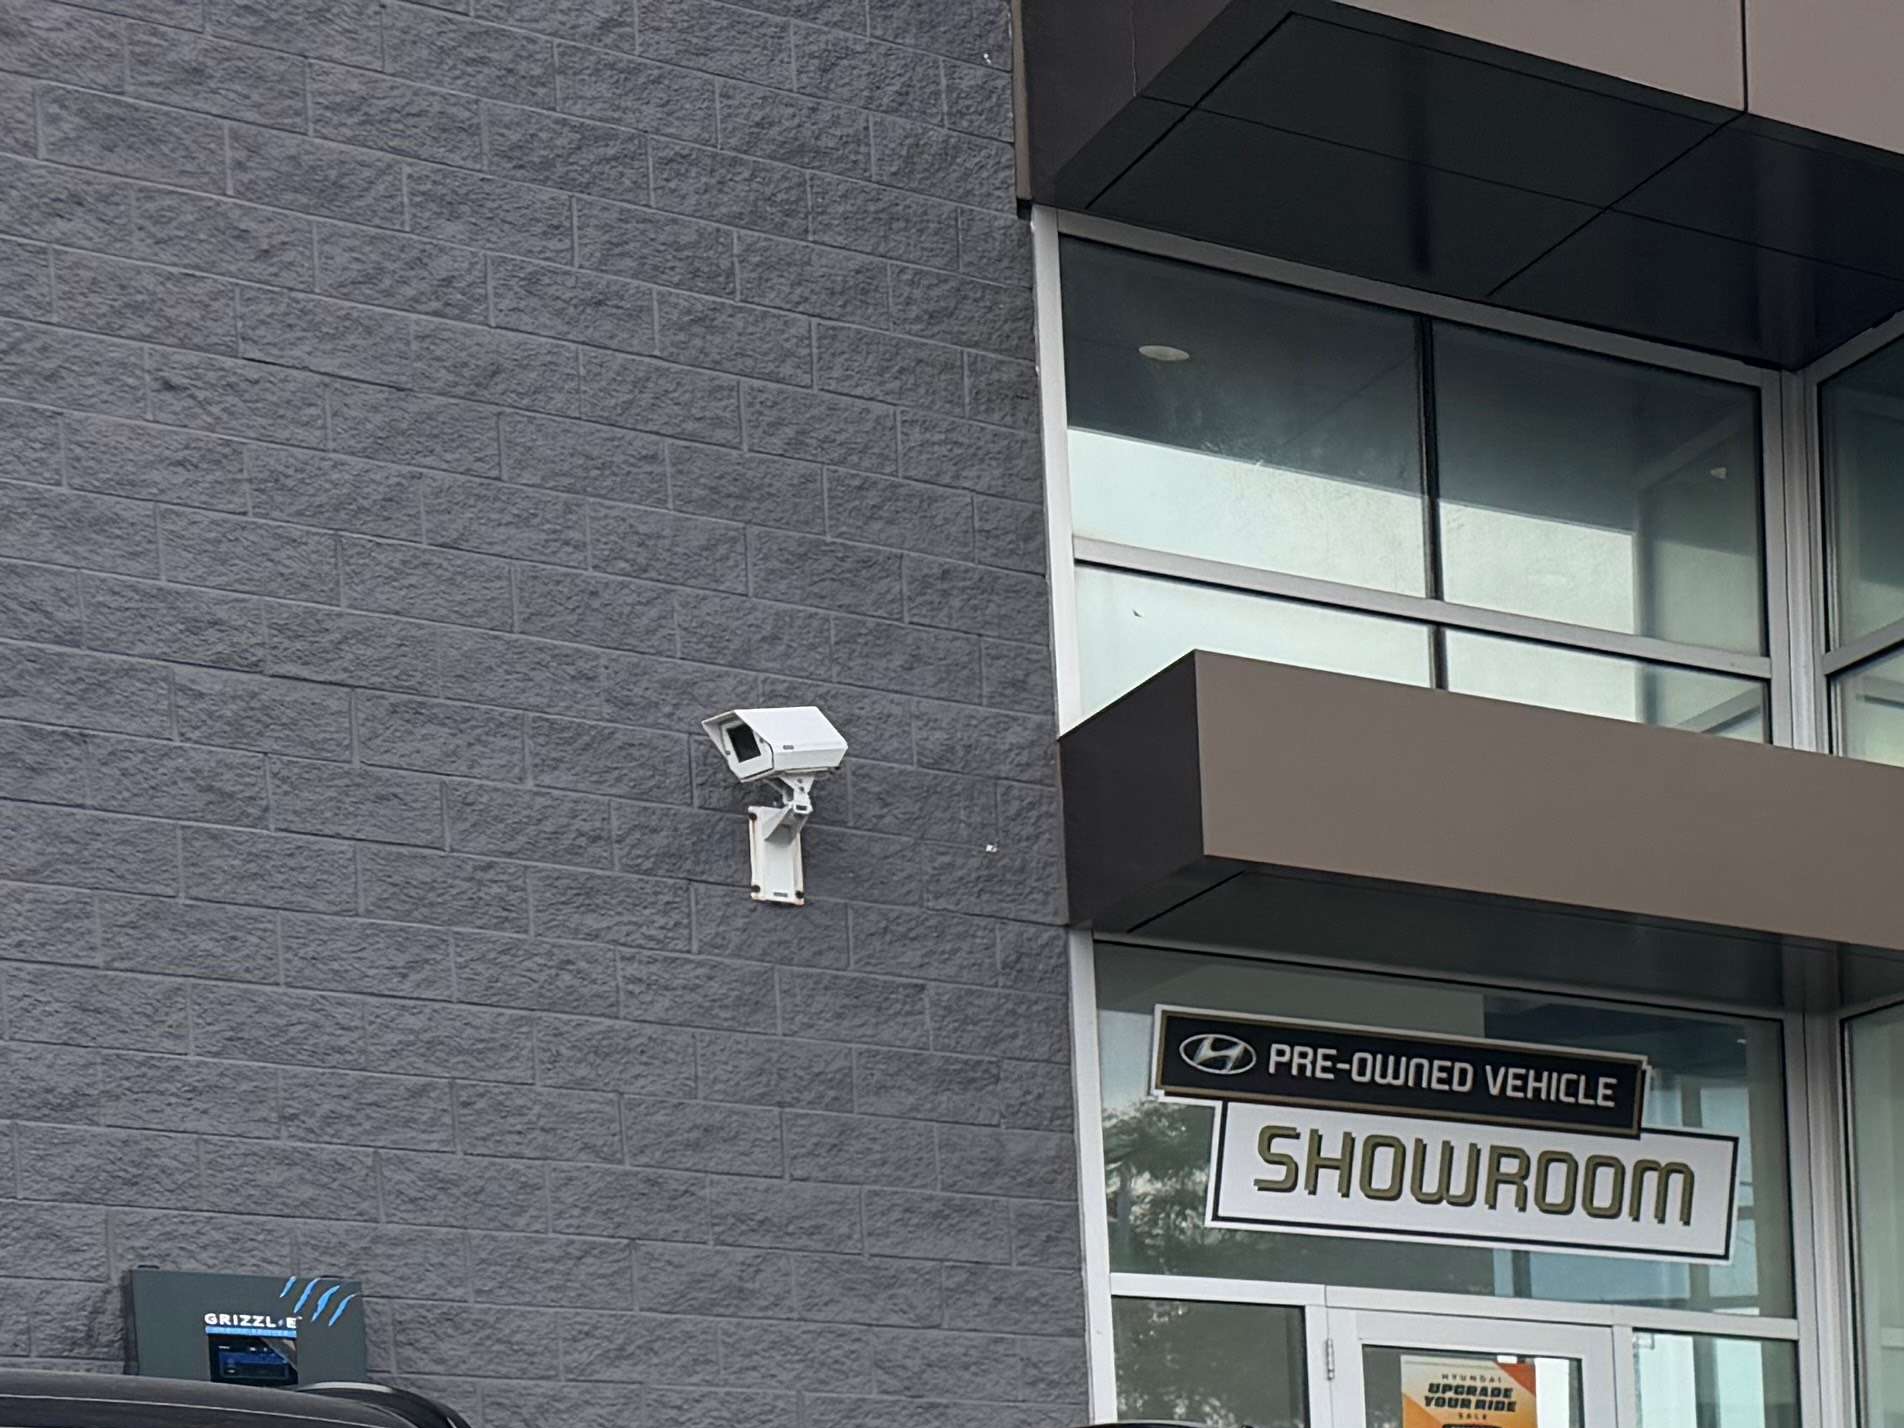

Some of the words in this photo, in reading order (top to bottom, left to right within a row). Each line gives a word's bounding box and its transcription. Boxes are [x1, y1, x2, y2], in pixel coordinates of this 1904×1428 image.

[1268, 1043, 1474, 1093] PRE-OWNED
[1485, 1065, 1617, 1108] VEHICLE
[1253, 1124, 1695, 1227] SHOWROOM
[1424, 1395, 1472, 1410] YOUR
[1474, 1400, 1517, 1413] RIDE
[1427, 1383, 1514, 1399] UPGRADE
